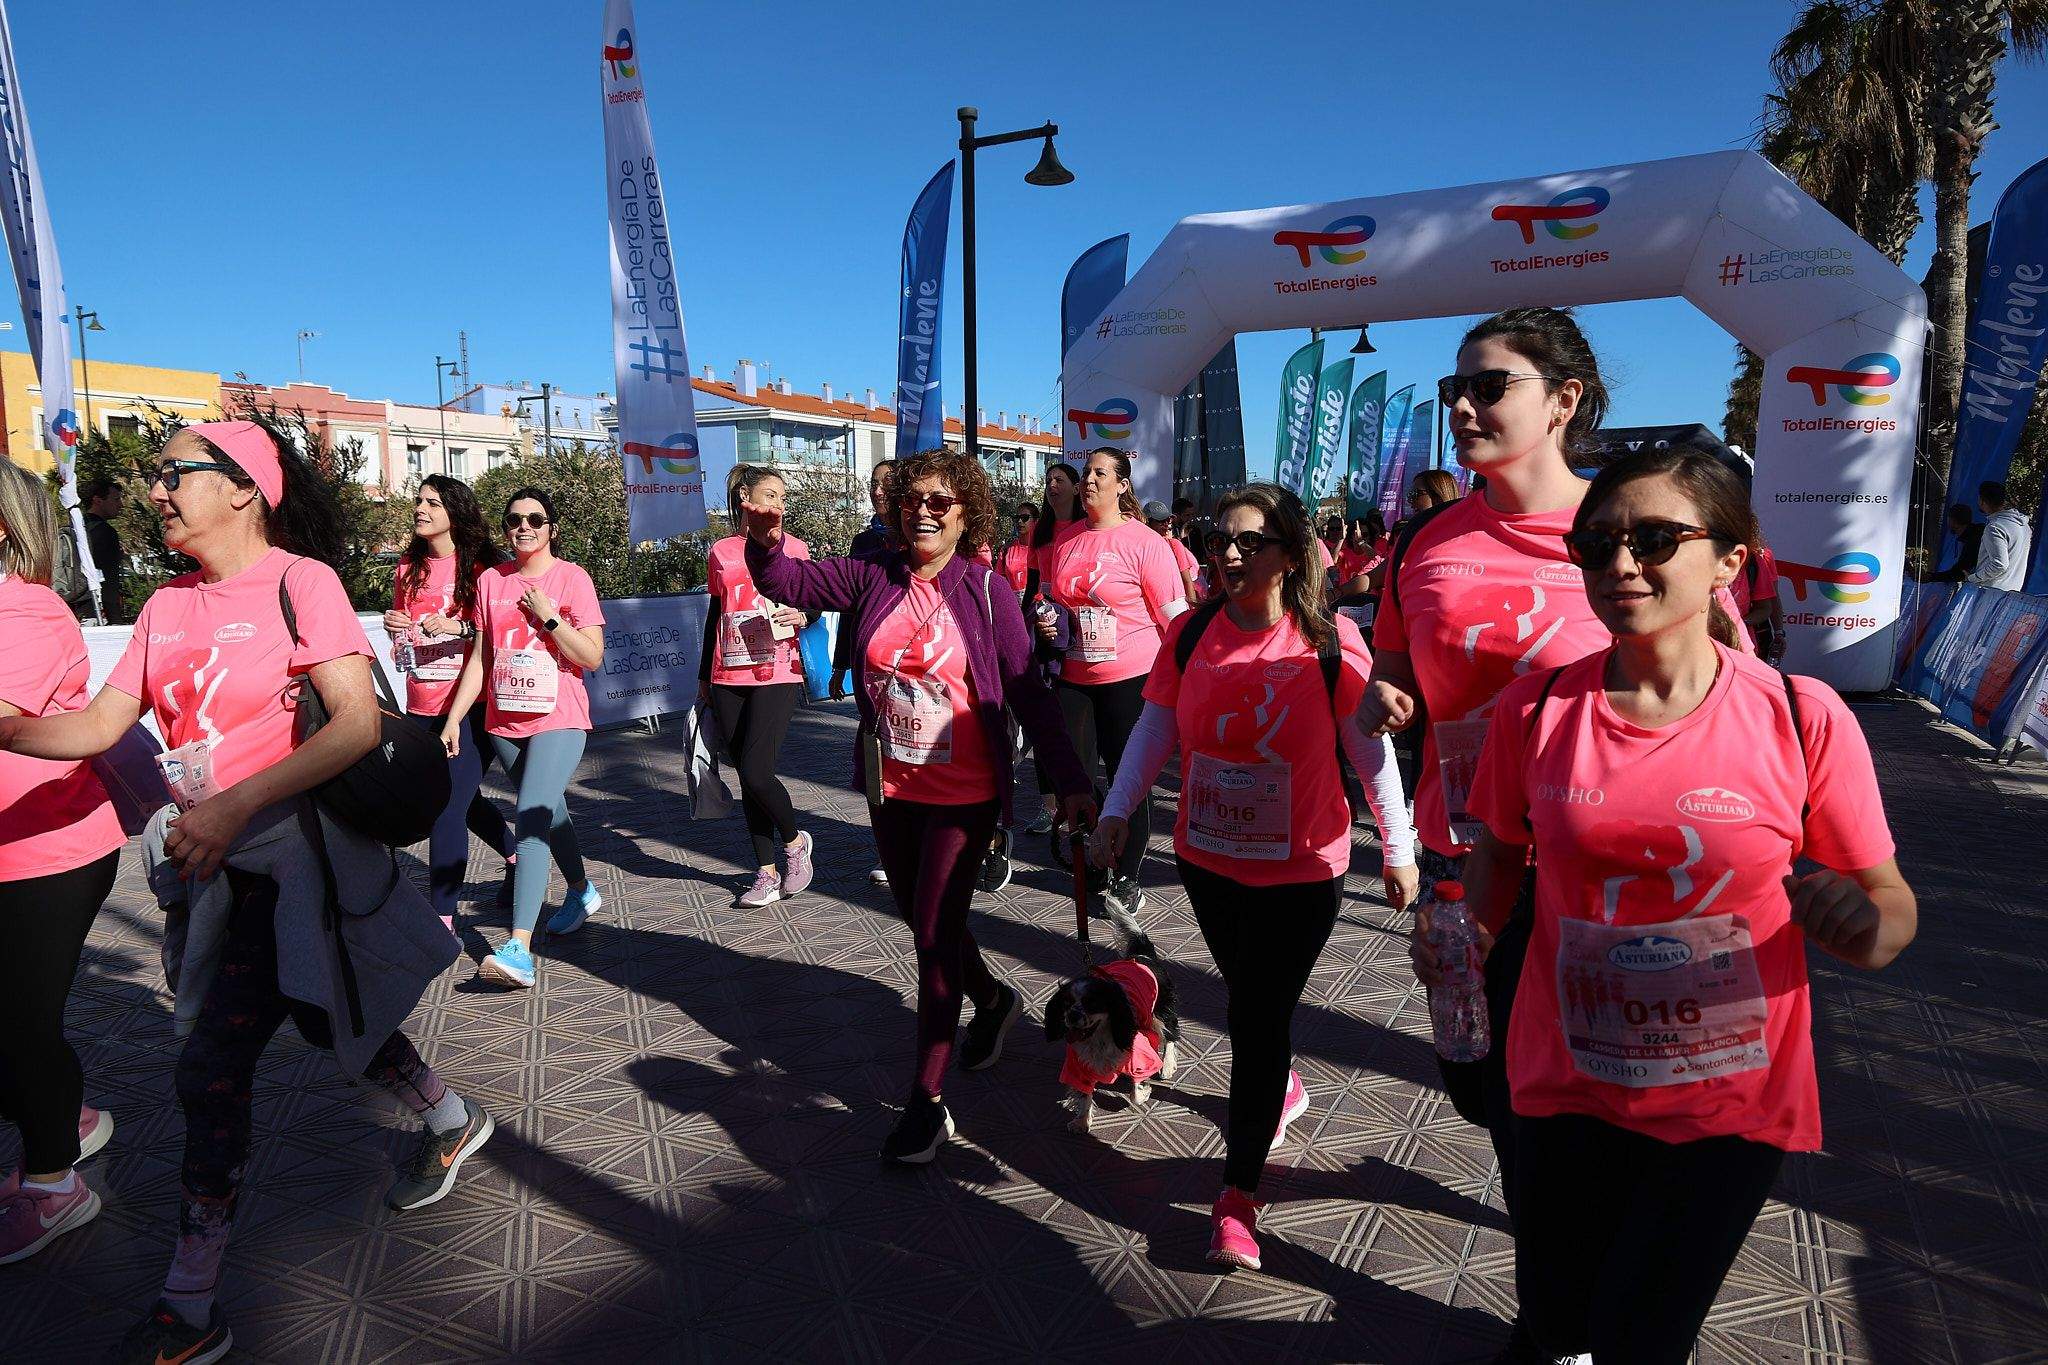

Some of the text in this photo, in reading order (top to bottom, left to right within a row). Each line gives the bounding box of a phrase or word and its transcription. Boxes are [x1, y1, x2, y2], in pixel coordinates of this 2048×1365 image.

[642, 156, 679, 329] LasCarreras
[1491, 249, 1610, 274] TotalEnergies
[1750, 263, 1855, 284] LasCarreras
[1274, 274, 1377, 294] TotalEnergies
[1114, 323, 1187, 337] LasCarreras
[899, 279, 939, 424] Marlene
[1965, 263, 2048, 422] Marlene
[1203, 367, 1236, 375] OLVO
[1782, 417, 1896, 433] TotalEnergies
[1279, 373, 1316, 498] Batiste
[1311, 388, 1345, 499] Batiste
[1350, 399, 1380, 502] Batiste
[627, 482, 702, 495] TotalEnergies
[1775, 491, 1888, 505] totalenergies.es
[1539, 569, 1583, 581] ASTURIAN
[1782, 612, 1876, 631] alEnergies
[1083, 632, 1097, 640] 16
[604, 651, 686, 675] LasCarreras
[510, 677, 535, 688] 016
[607, 683, 672, 699] totalenergies.es
[891, 714, 922, 731] 016
[1536, 783, 1605, 806] OYSHO
[1217, 803, 1256, 822] 016
[1683, 798, 1749, 817] ASTURIANA
[1613, 949, 1687, 963] ASTURIANA
[1623, 998, 1702, 1026] 016
[1630, 1048, 1642, 1057] DE
[1698, 1036, 1740, 1051] VALENCIA
[1642, 1032, 1680, 1045] 9244
[1588, 1059, 1648, 1078] OYSHO
[1688, 1052, 1745, 1072] Santander
